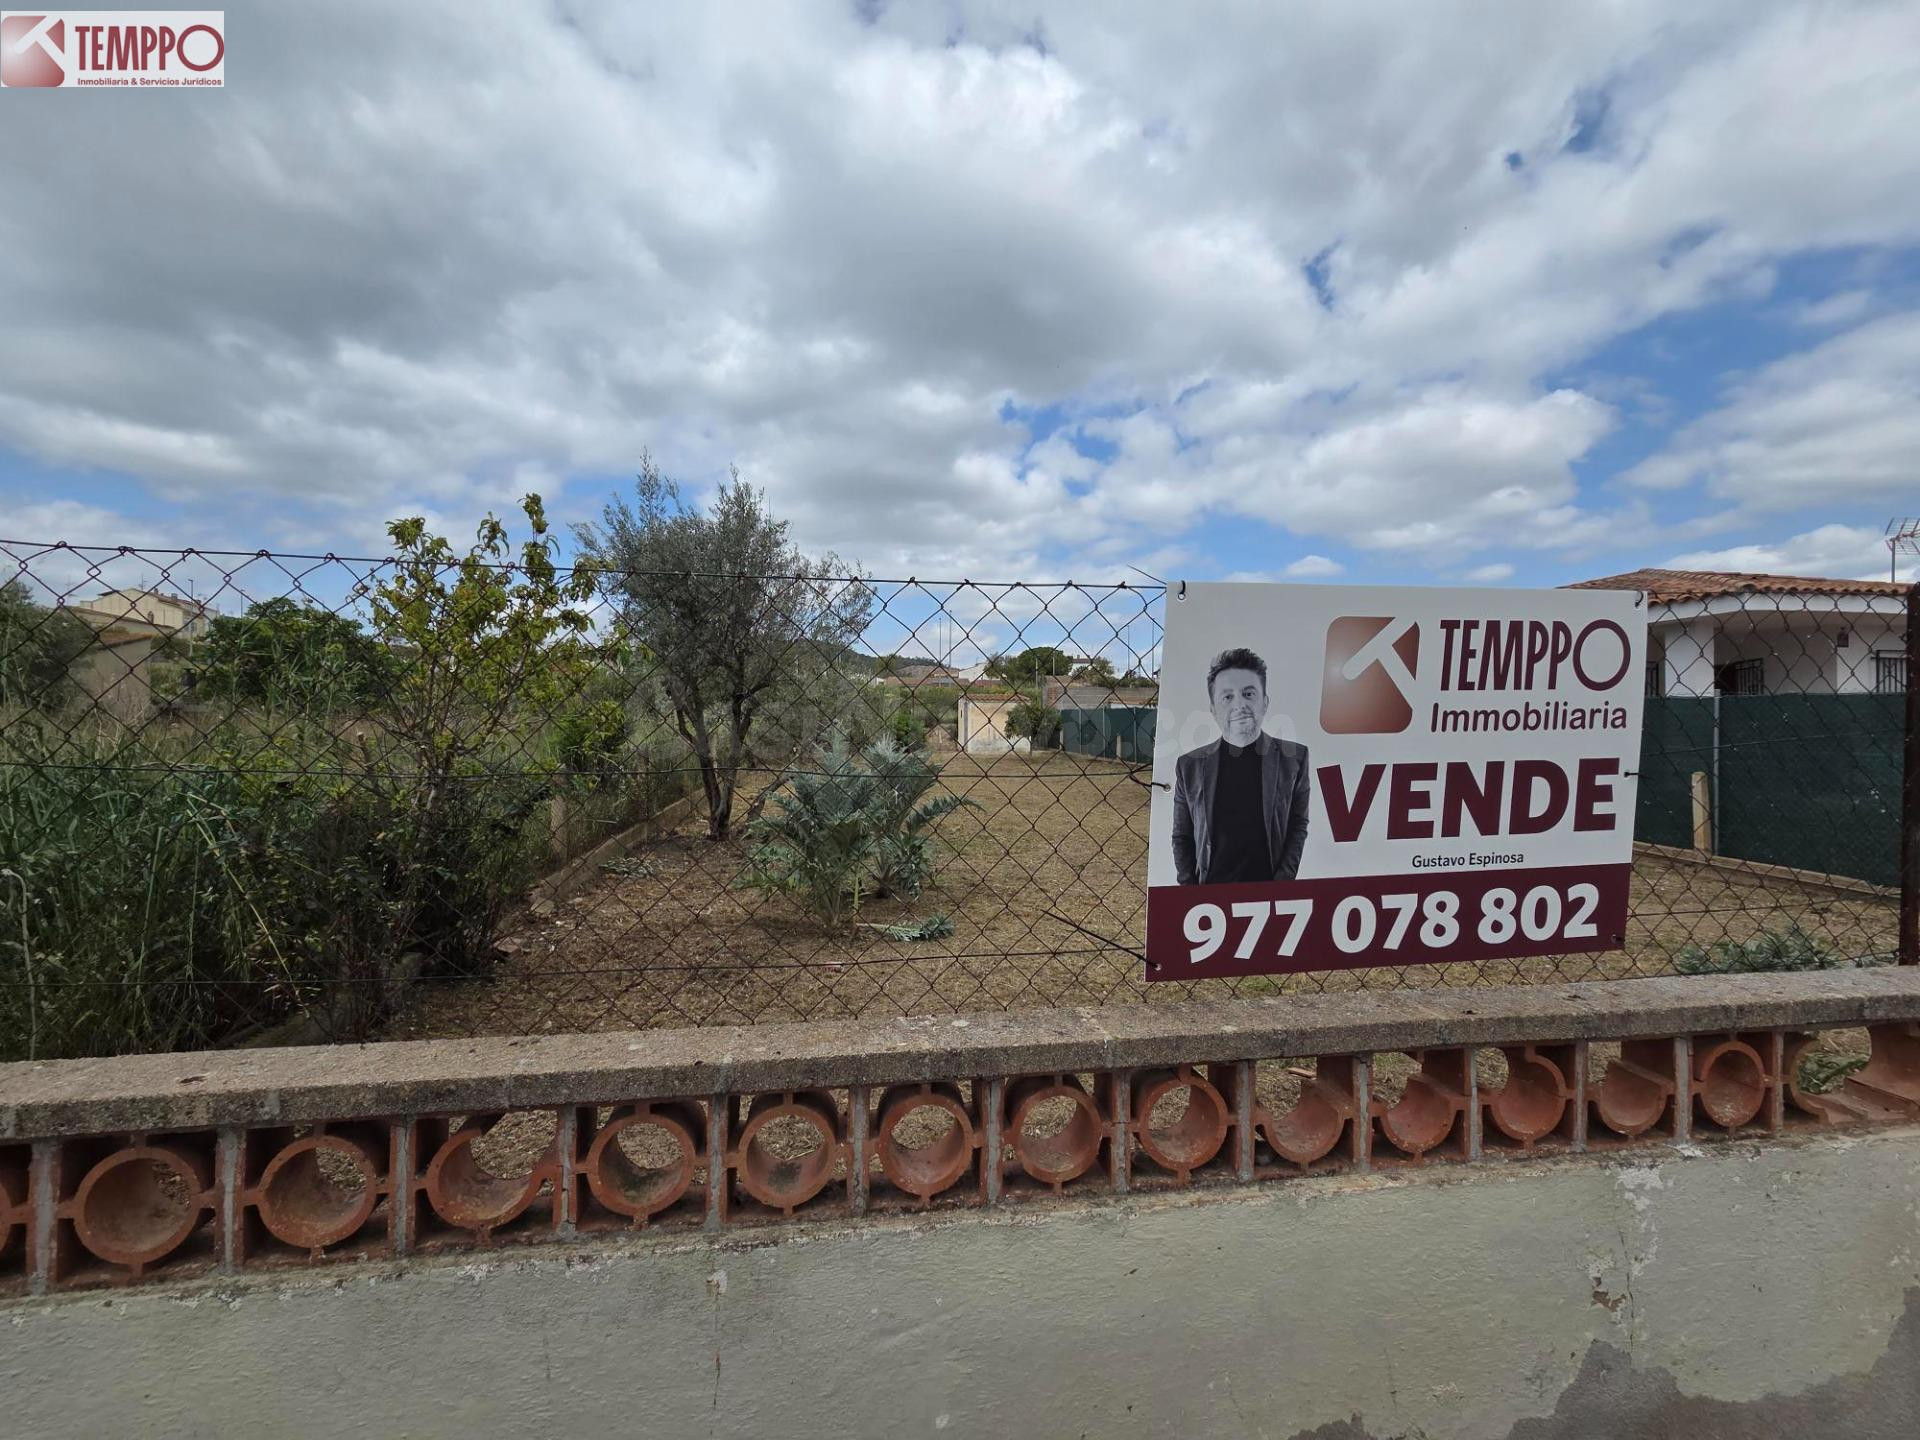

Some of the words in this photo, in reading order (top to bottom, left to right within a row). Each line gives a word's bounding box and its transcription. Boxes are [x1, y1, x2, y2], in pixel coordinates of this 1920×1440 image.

[1440, 619, 1631, 691] TEMPPO
[1430, 701, 1628, 733] Immobiliaria
[1316, 758, 1620, 842] VENDE
[1412, 855, 1465, 868] Gustavo
[1468, 852, 1524, 867] Espinosa
[1182, 899, 1313, 964] 977
[1331, 890, 1460, 953] 078
[1477, 882, 1600, 945] 802
